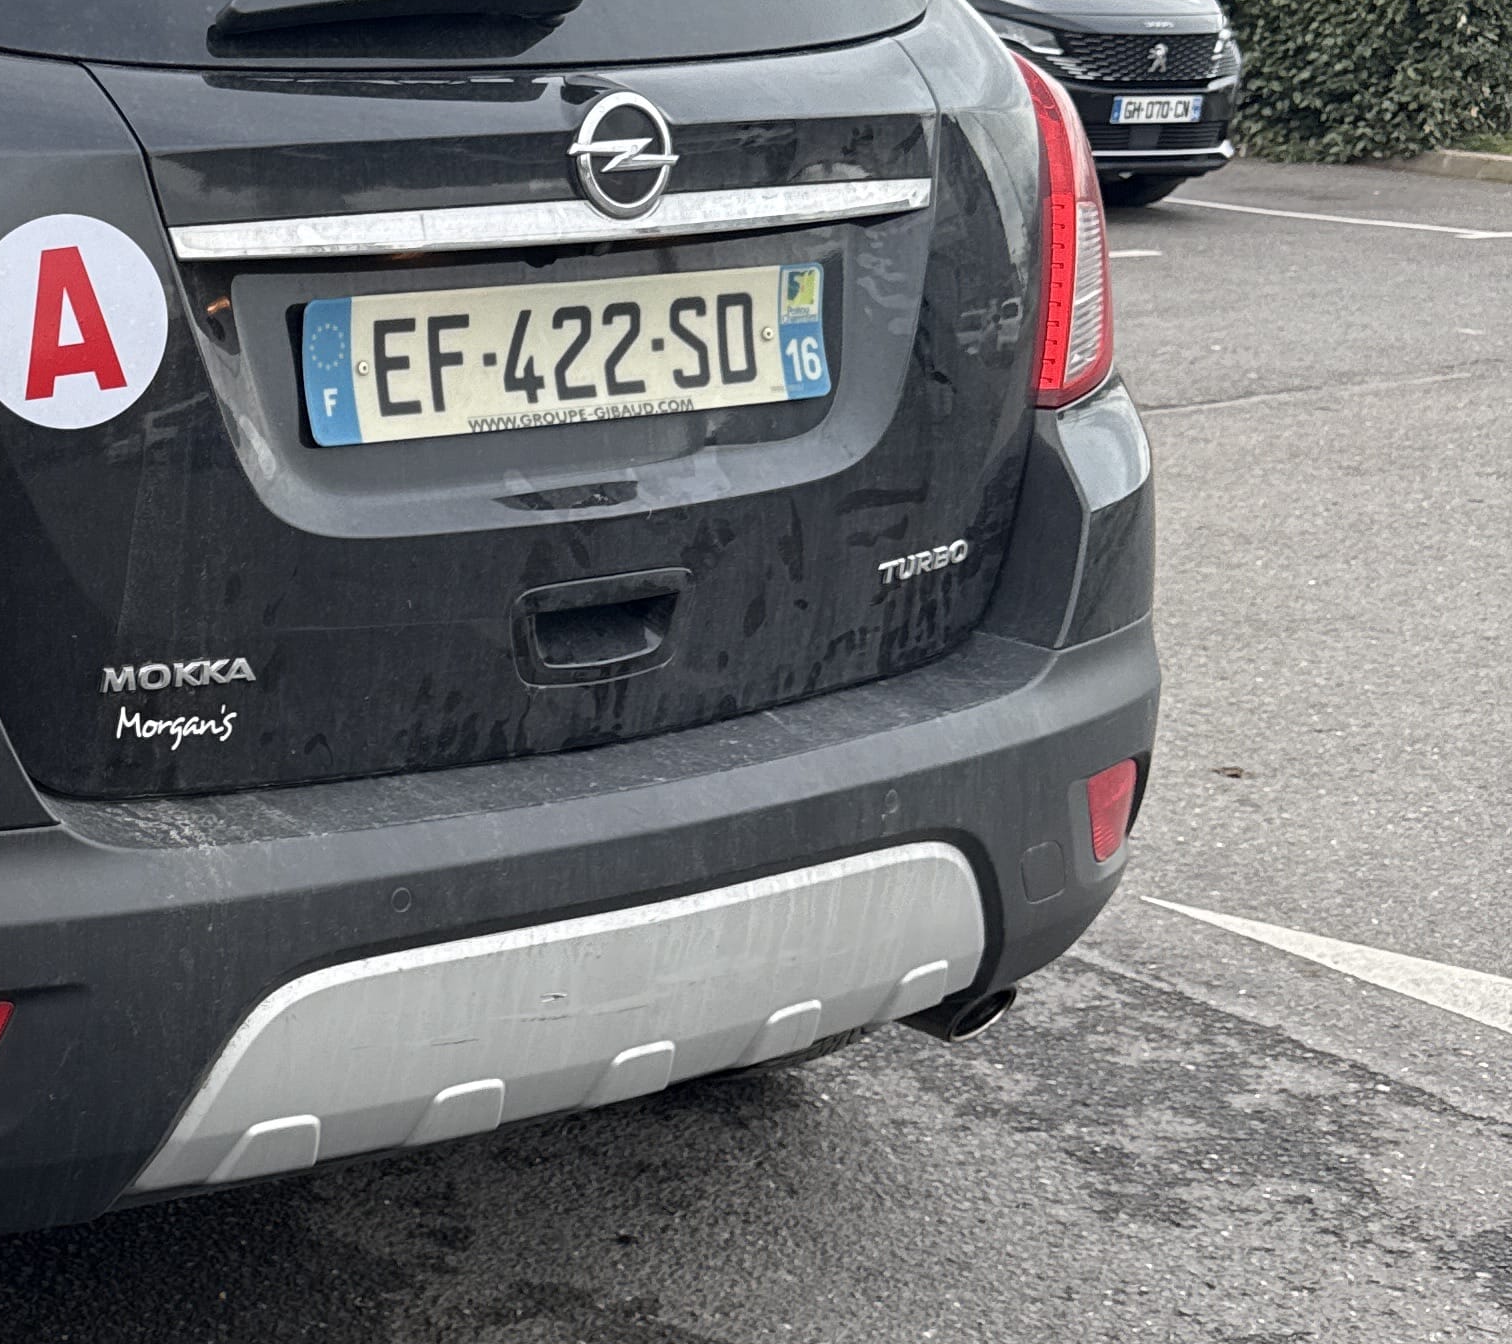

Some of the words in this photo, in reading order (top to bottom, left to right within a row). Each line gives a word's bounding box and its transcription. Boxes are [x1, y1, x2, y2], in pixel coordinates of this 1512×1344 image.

[25, 245, 128, 401] A
[373, 292, 758, 418] EF-422-SD
[785, 336, 823, 383] 16
[323, 387, 338, 417] F
[467, 398, 695, 433] WWW.GROUPE-GIBAUD.COM
[877, 538, 970, 585] TURBO
[100, 657, 256, 694] MOKKA
[116, 704, 237, 751] Morgan's
